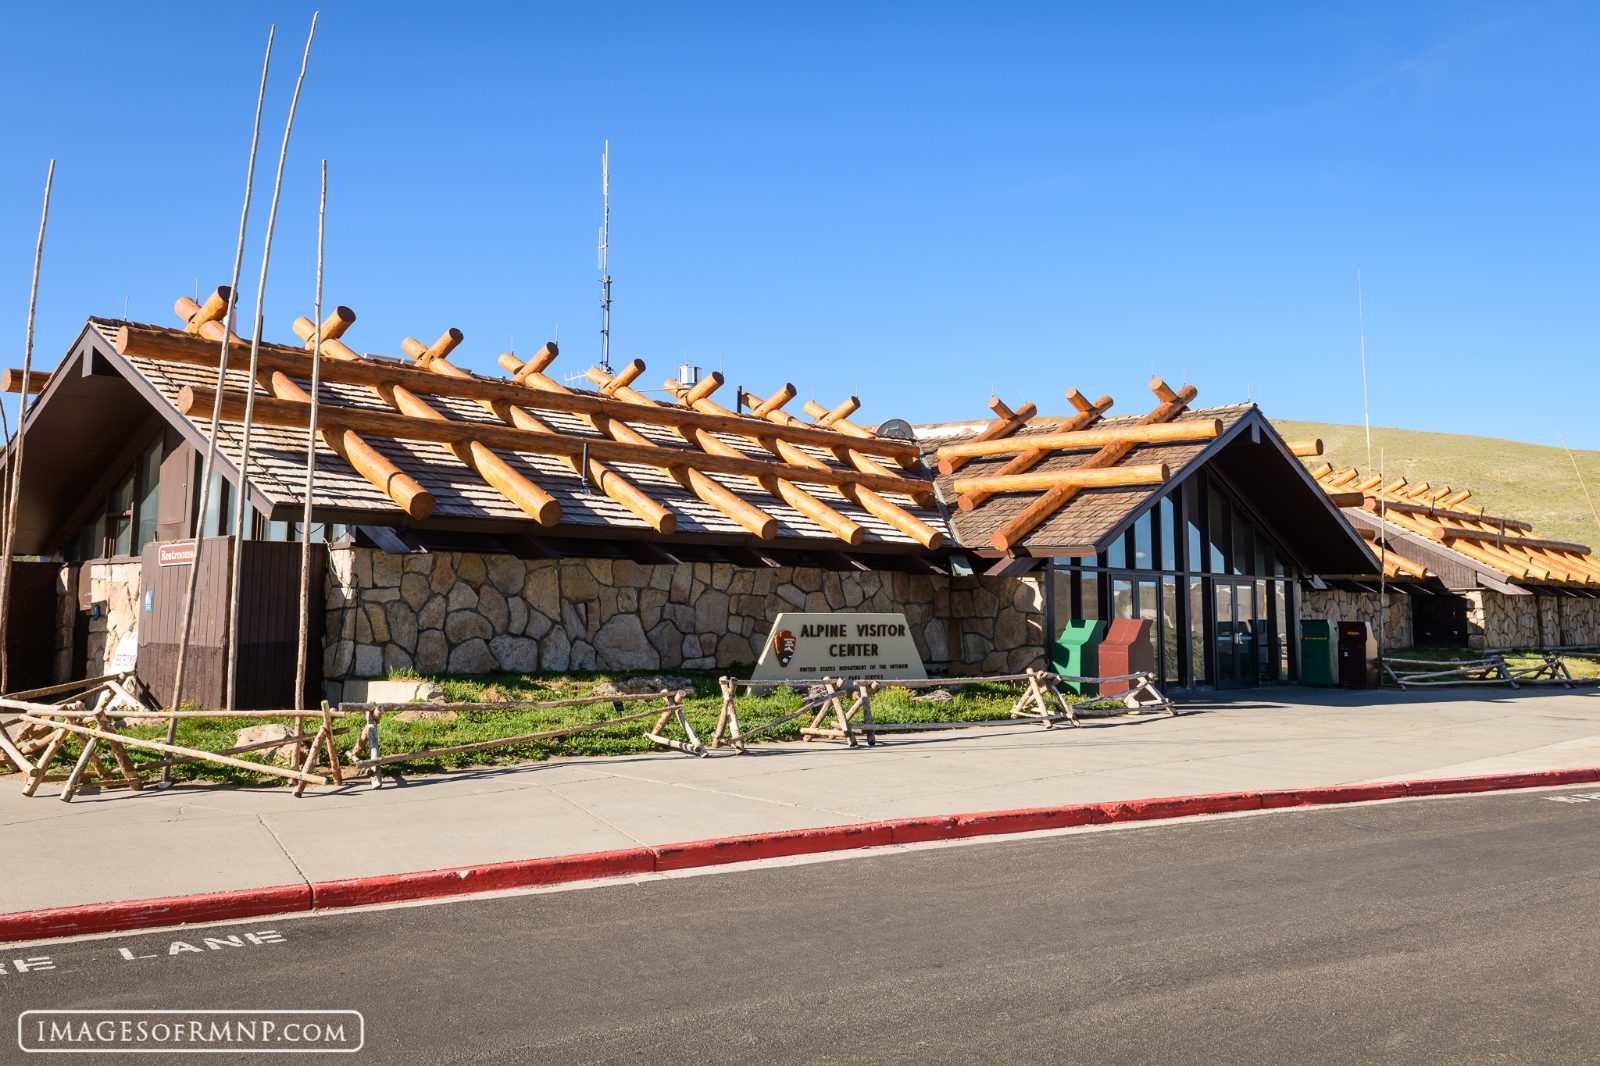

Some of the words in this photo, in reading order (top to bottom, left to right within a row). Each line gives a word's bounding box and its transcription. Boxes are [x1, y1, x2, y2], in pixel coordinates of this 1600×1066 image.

[161, 550, 193, 560] Restrooms
[800, 624, 848, 638] ALPINE
[856, 624, 906, 637] VISITOR
[829, 643, 879, 657] CENTER
[0, 956, 56, 975] E
[118, 930, 288, 961] LANE
